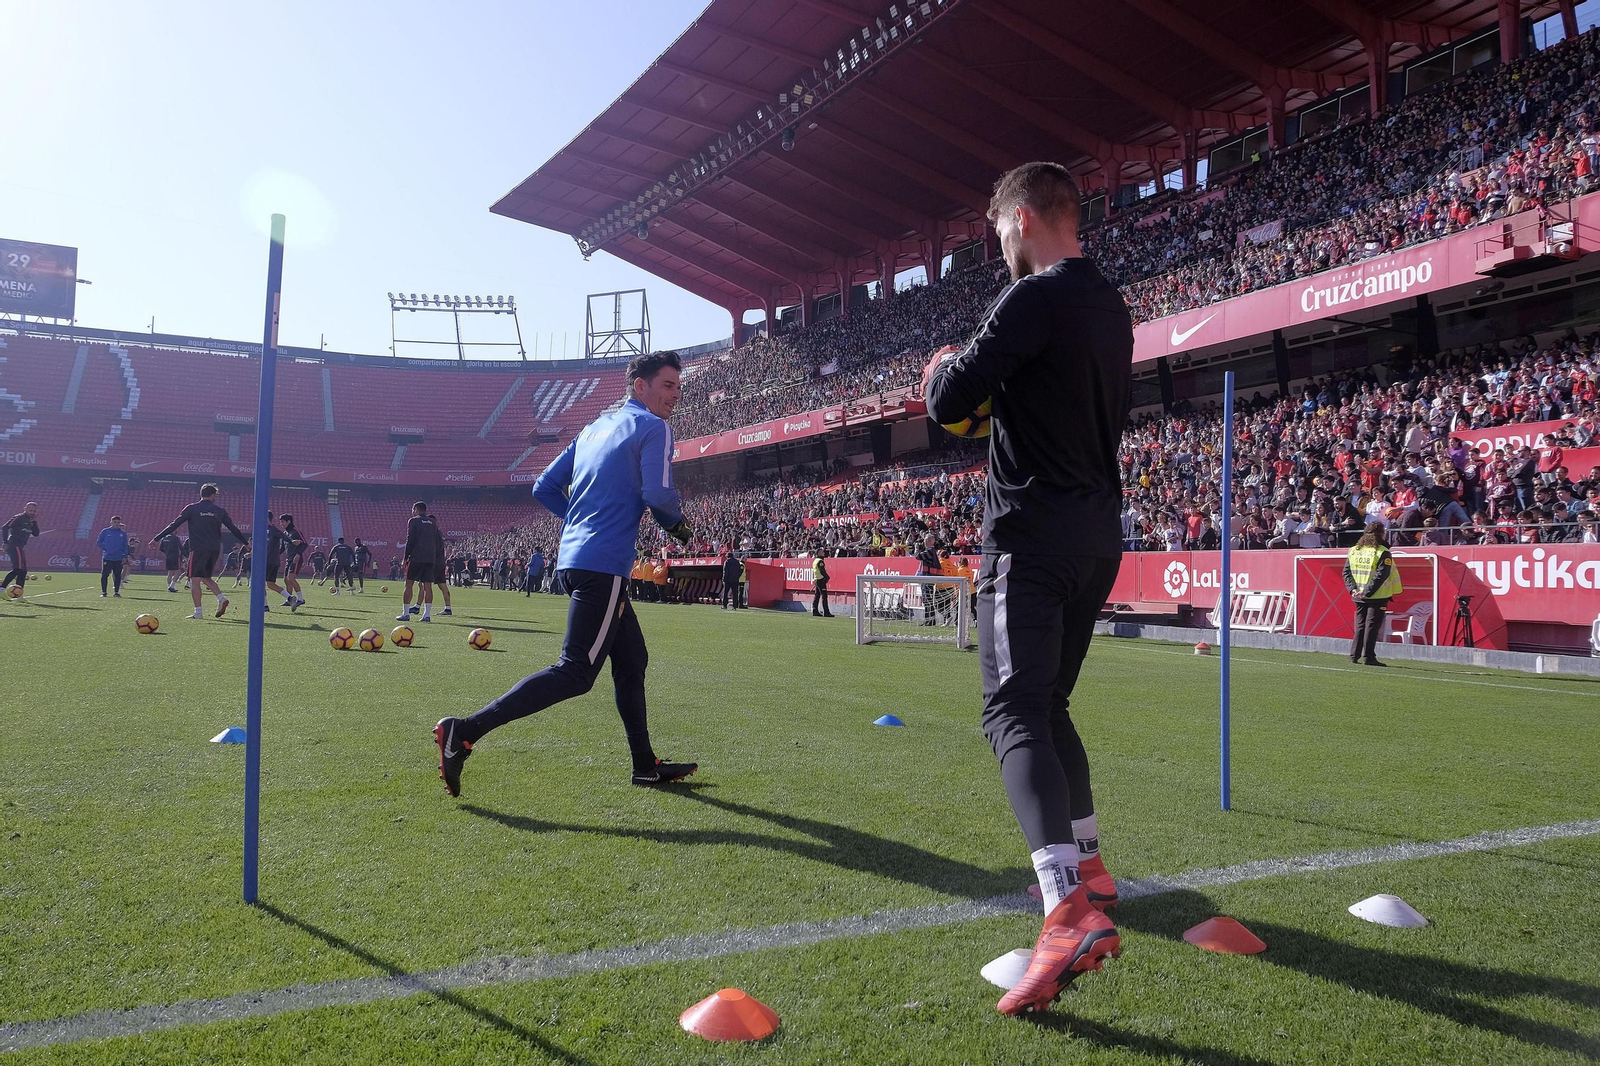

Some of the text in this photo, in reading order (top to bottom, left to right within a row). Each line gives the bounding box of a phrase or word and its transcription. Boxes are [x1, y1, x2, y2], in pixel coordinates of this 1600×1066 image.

[7, 253, 31, 268] 29
[1301, 260, 1432, 312] Cruzcampo
[3, 290, 33, 299] MEDIO
[10, 321, 37, 330] Sevilla
[738, 429, 772, 445] Cruzcampo
[72, 457, 107, 465] Playtika
[240, 466, 256, 474] Play
[309, 537, 328, 547] ZTE
[1193, 569, 1249, 589] LaLga
